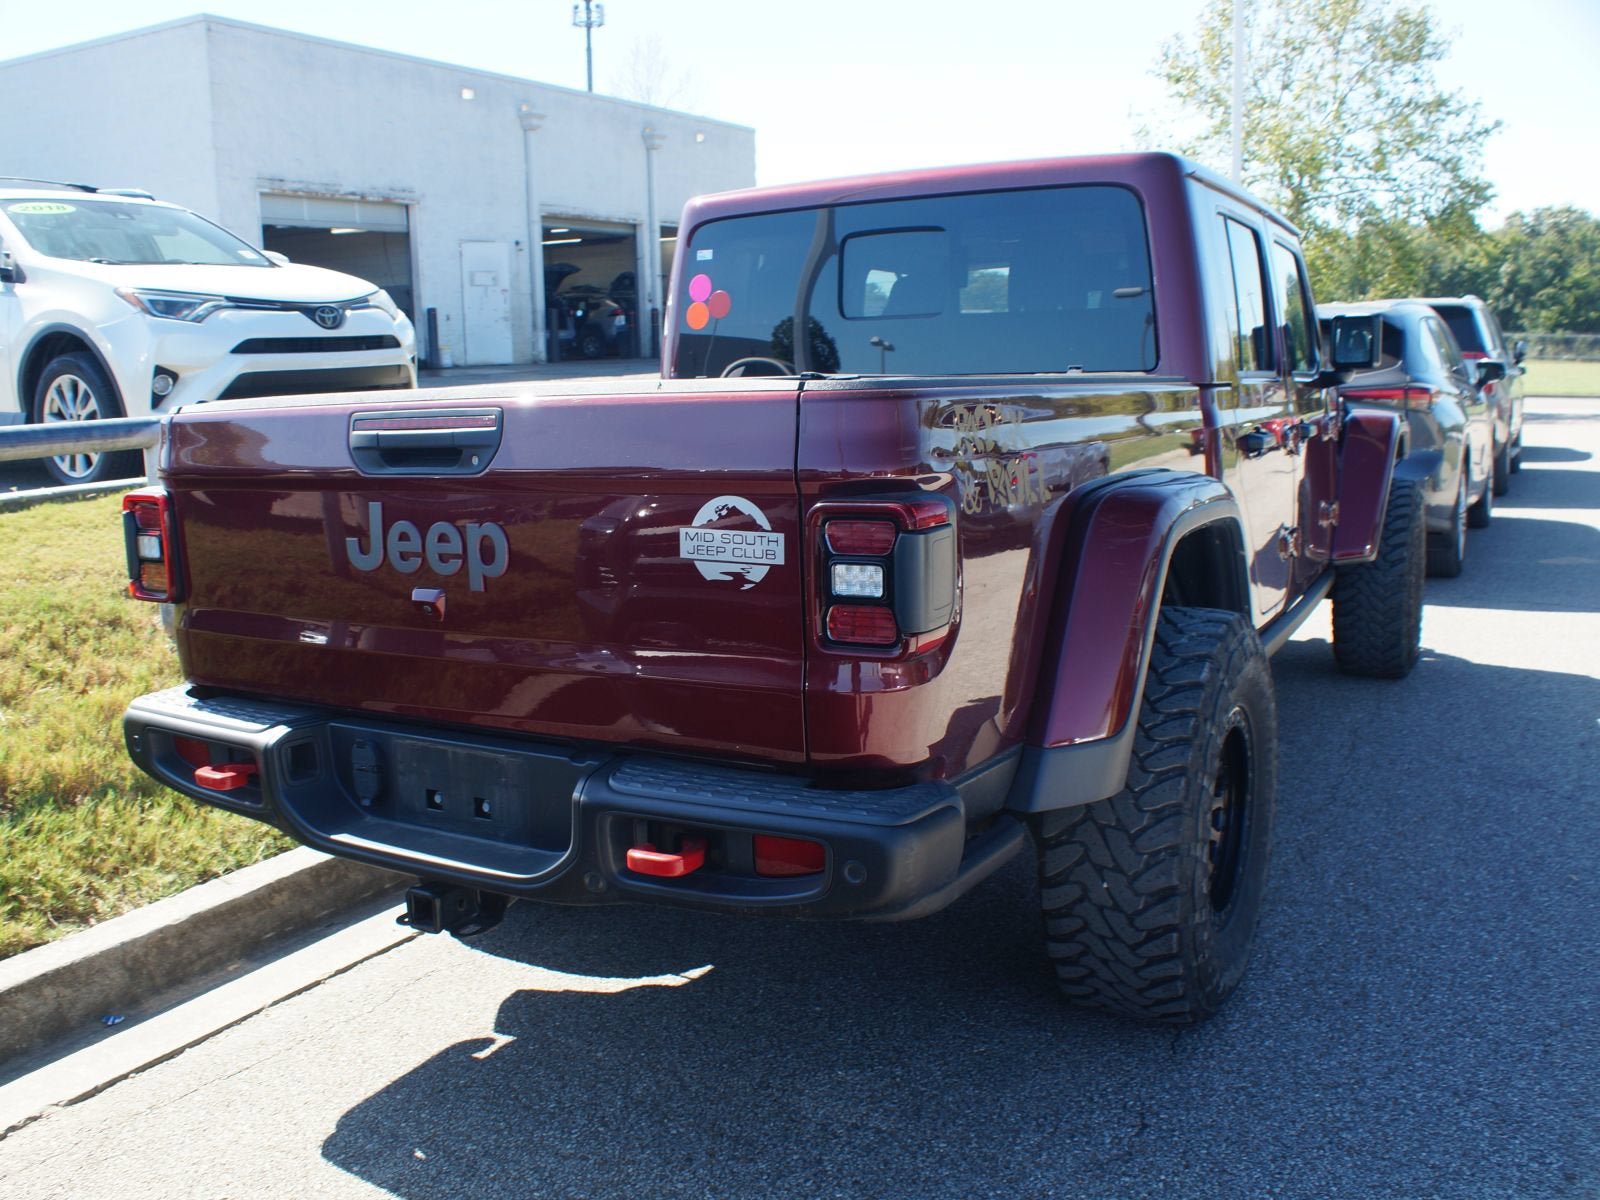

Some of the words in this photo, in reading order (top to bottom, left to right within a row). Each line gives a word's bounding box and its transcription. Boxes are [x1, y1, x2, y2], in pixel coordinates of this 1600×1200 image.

[963, 470, 983, 514] &
[985, 458, 1052, 513] ROLL
[344, 501, 509, 592] Jeep
[685, 531, 714, 542] MID
[720, 533, 779, 547] SOUTH
[687, 545, 726, 556] JEEP
[732, 547, 777, 560] CLUB
